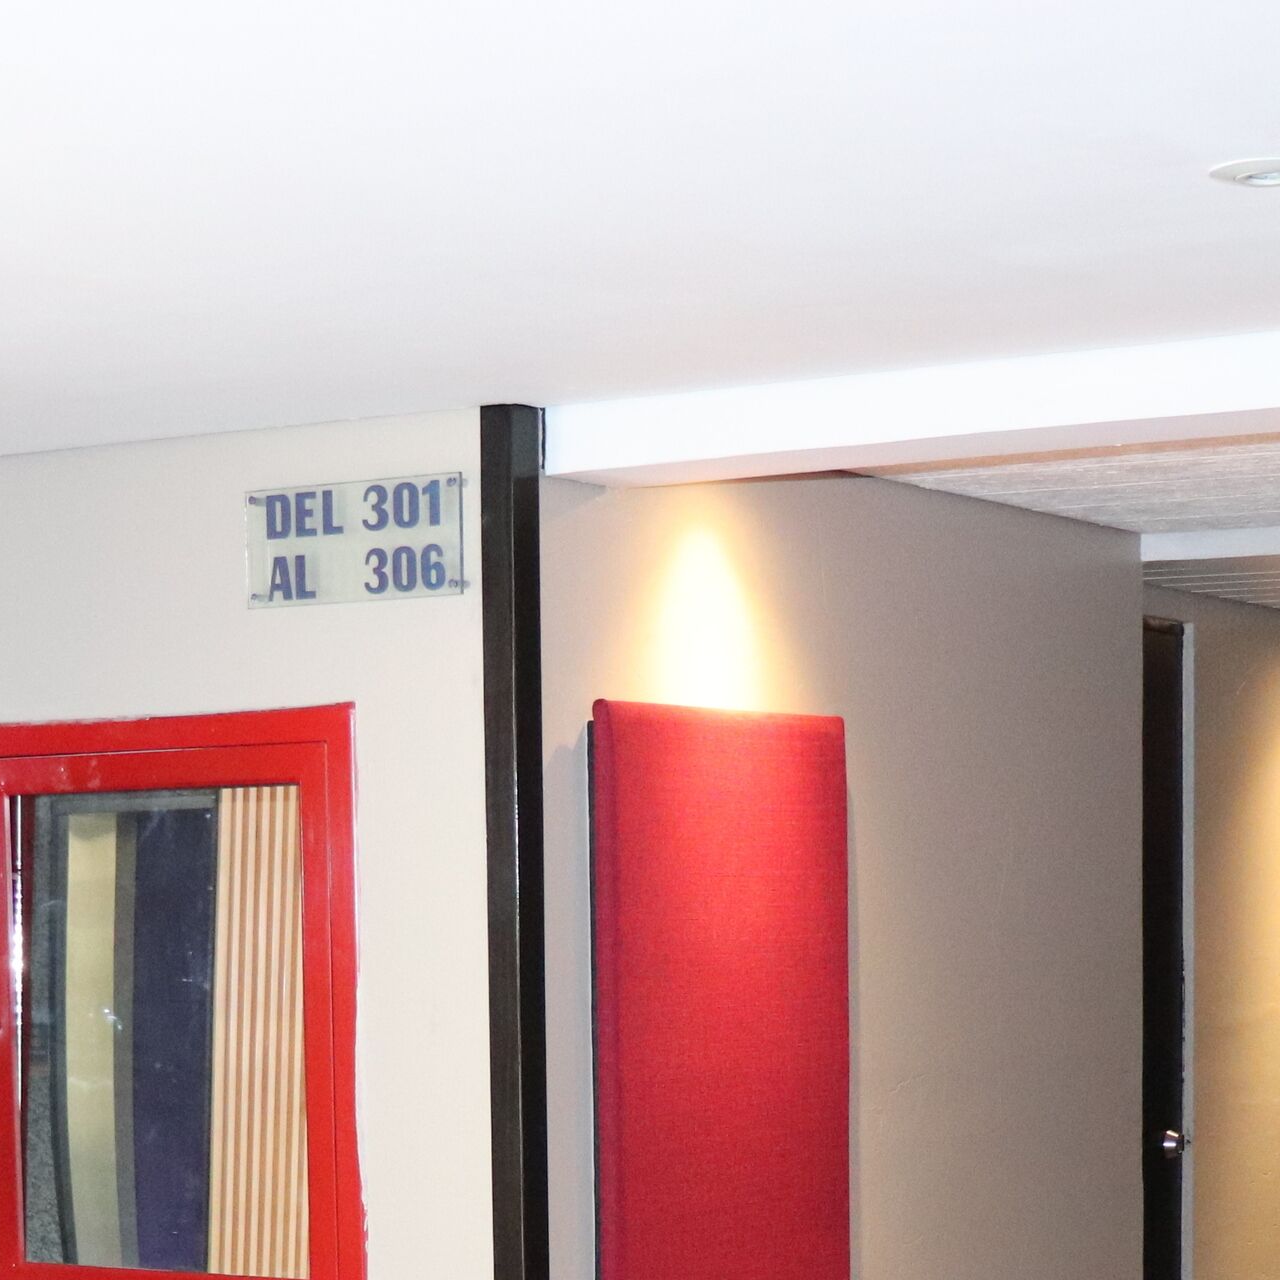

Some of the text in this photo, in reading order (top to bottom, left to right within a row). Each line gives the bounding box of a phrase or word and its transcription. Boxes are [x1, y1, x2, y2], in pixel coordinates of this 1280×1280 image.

[265, 479, 441, 540] DEL 301
[269, 543, 447, 602] AL 306
